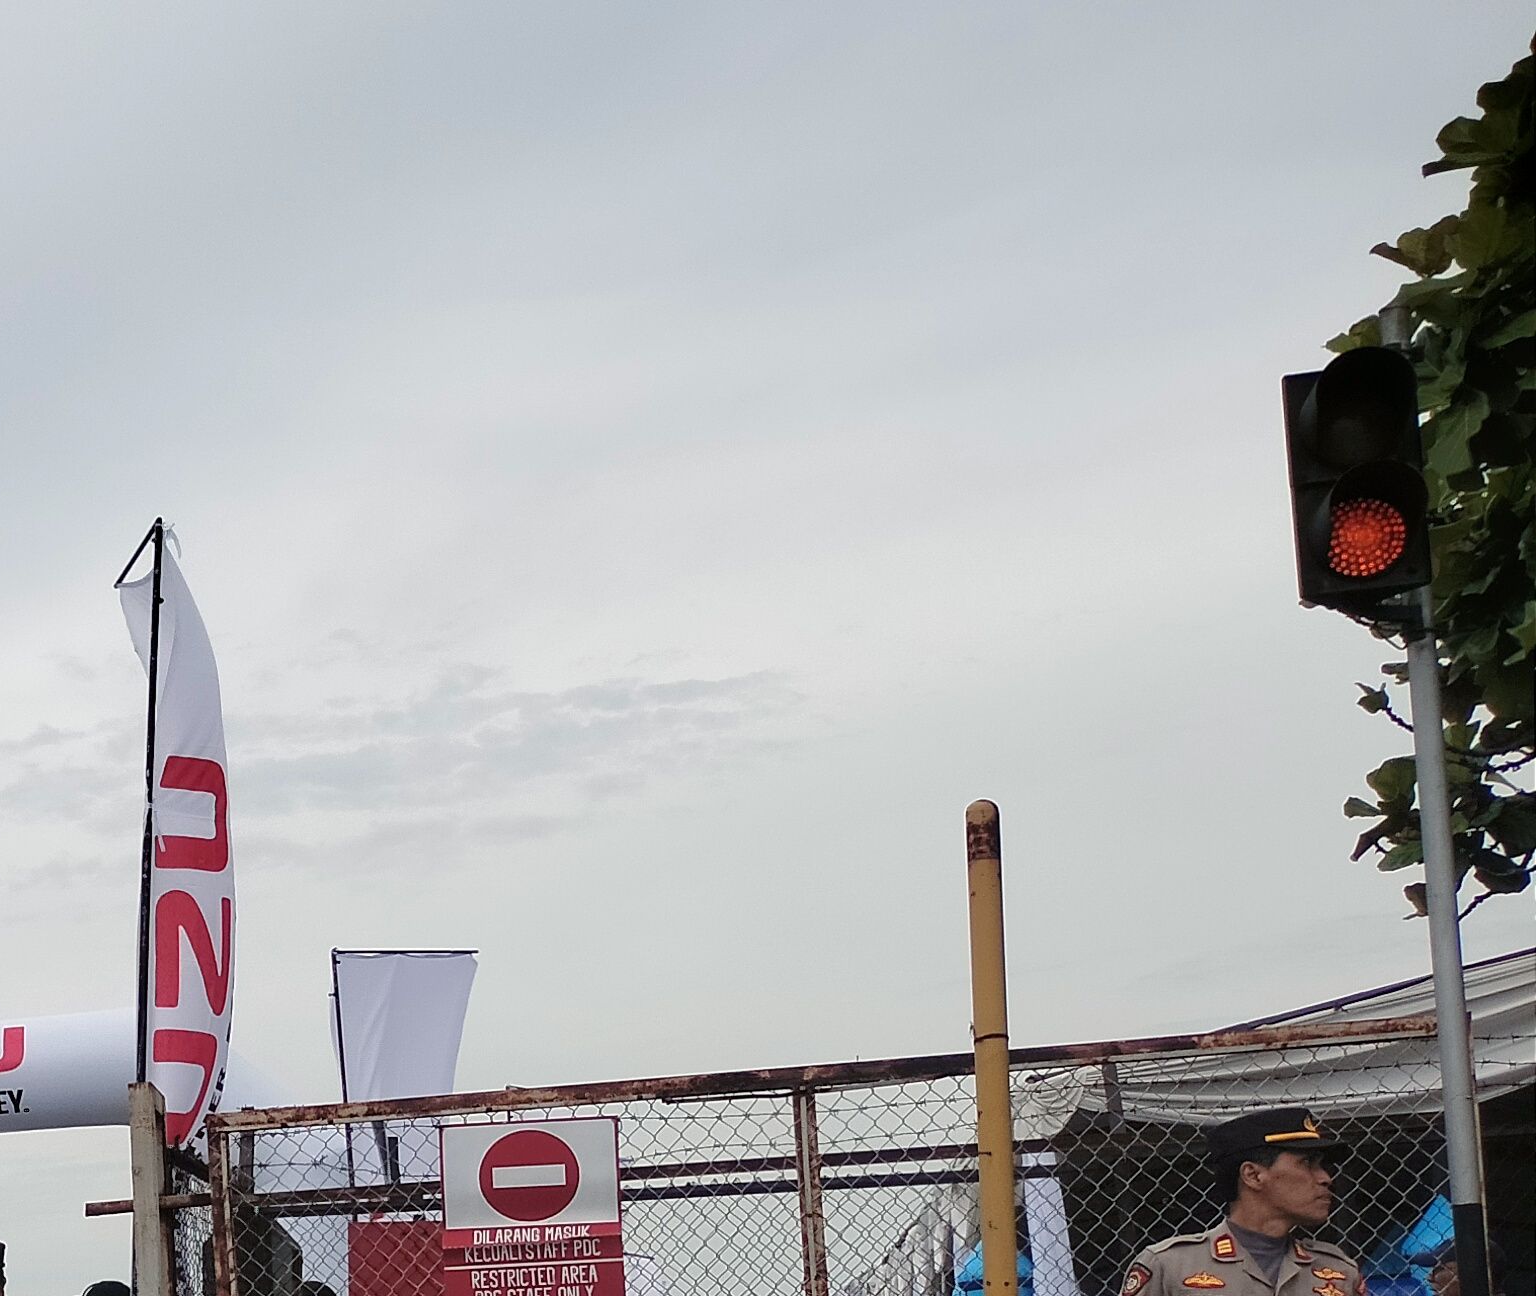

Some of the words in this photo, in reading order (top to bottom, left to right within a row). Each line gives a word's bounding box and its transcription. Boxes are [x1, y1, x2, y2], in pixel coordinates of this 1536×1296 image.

[473, 1228, 540, 1245] DILARANG
[545, 1225, 591, 1240] MASUK
[464, 1244, 522, 1263] KECUALI
[525, 1242, 568, 1260] STAFF
[573, 1239, 601, 1257] PDC
[471, 1266, 556, 1289] RESTRICTED
[561, 1265, 598, 1284] AREA
